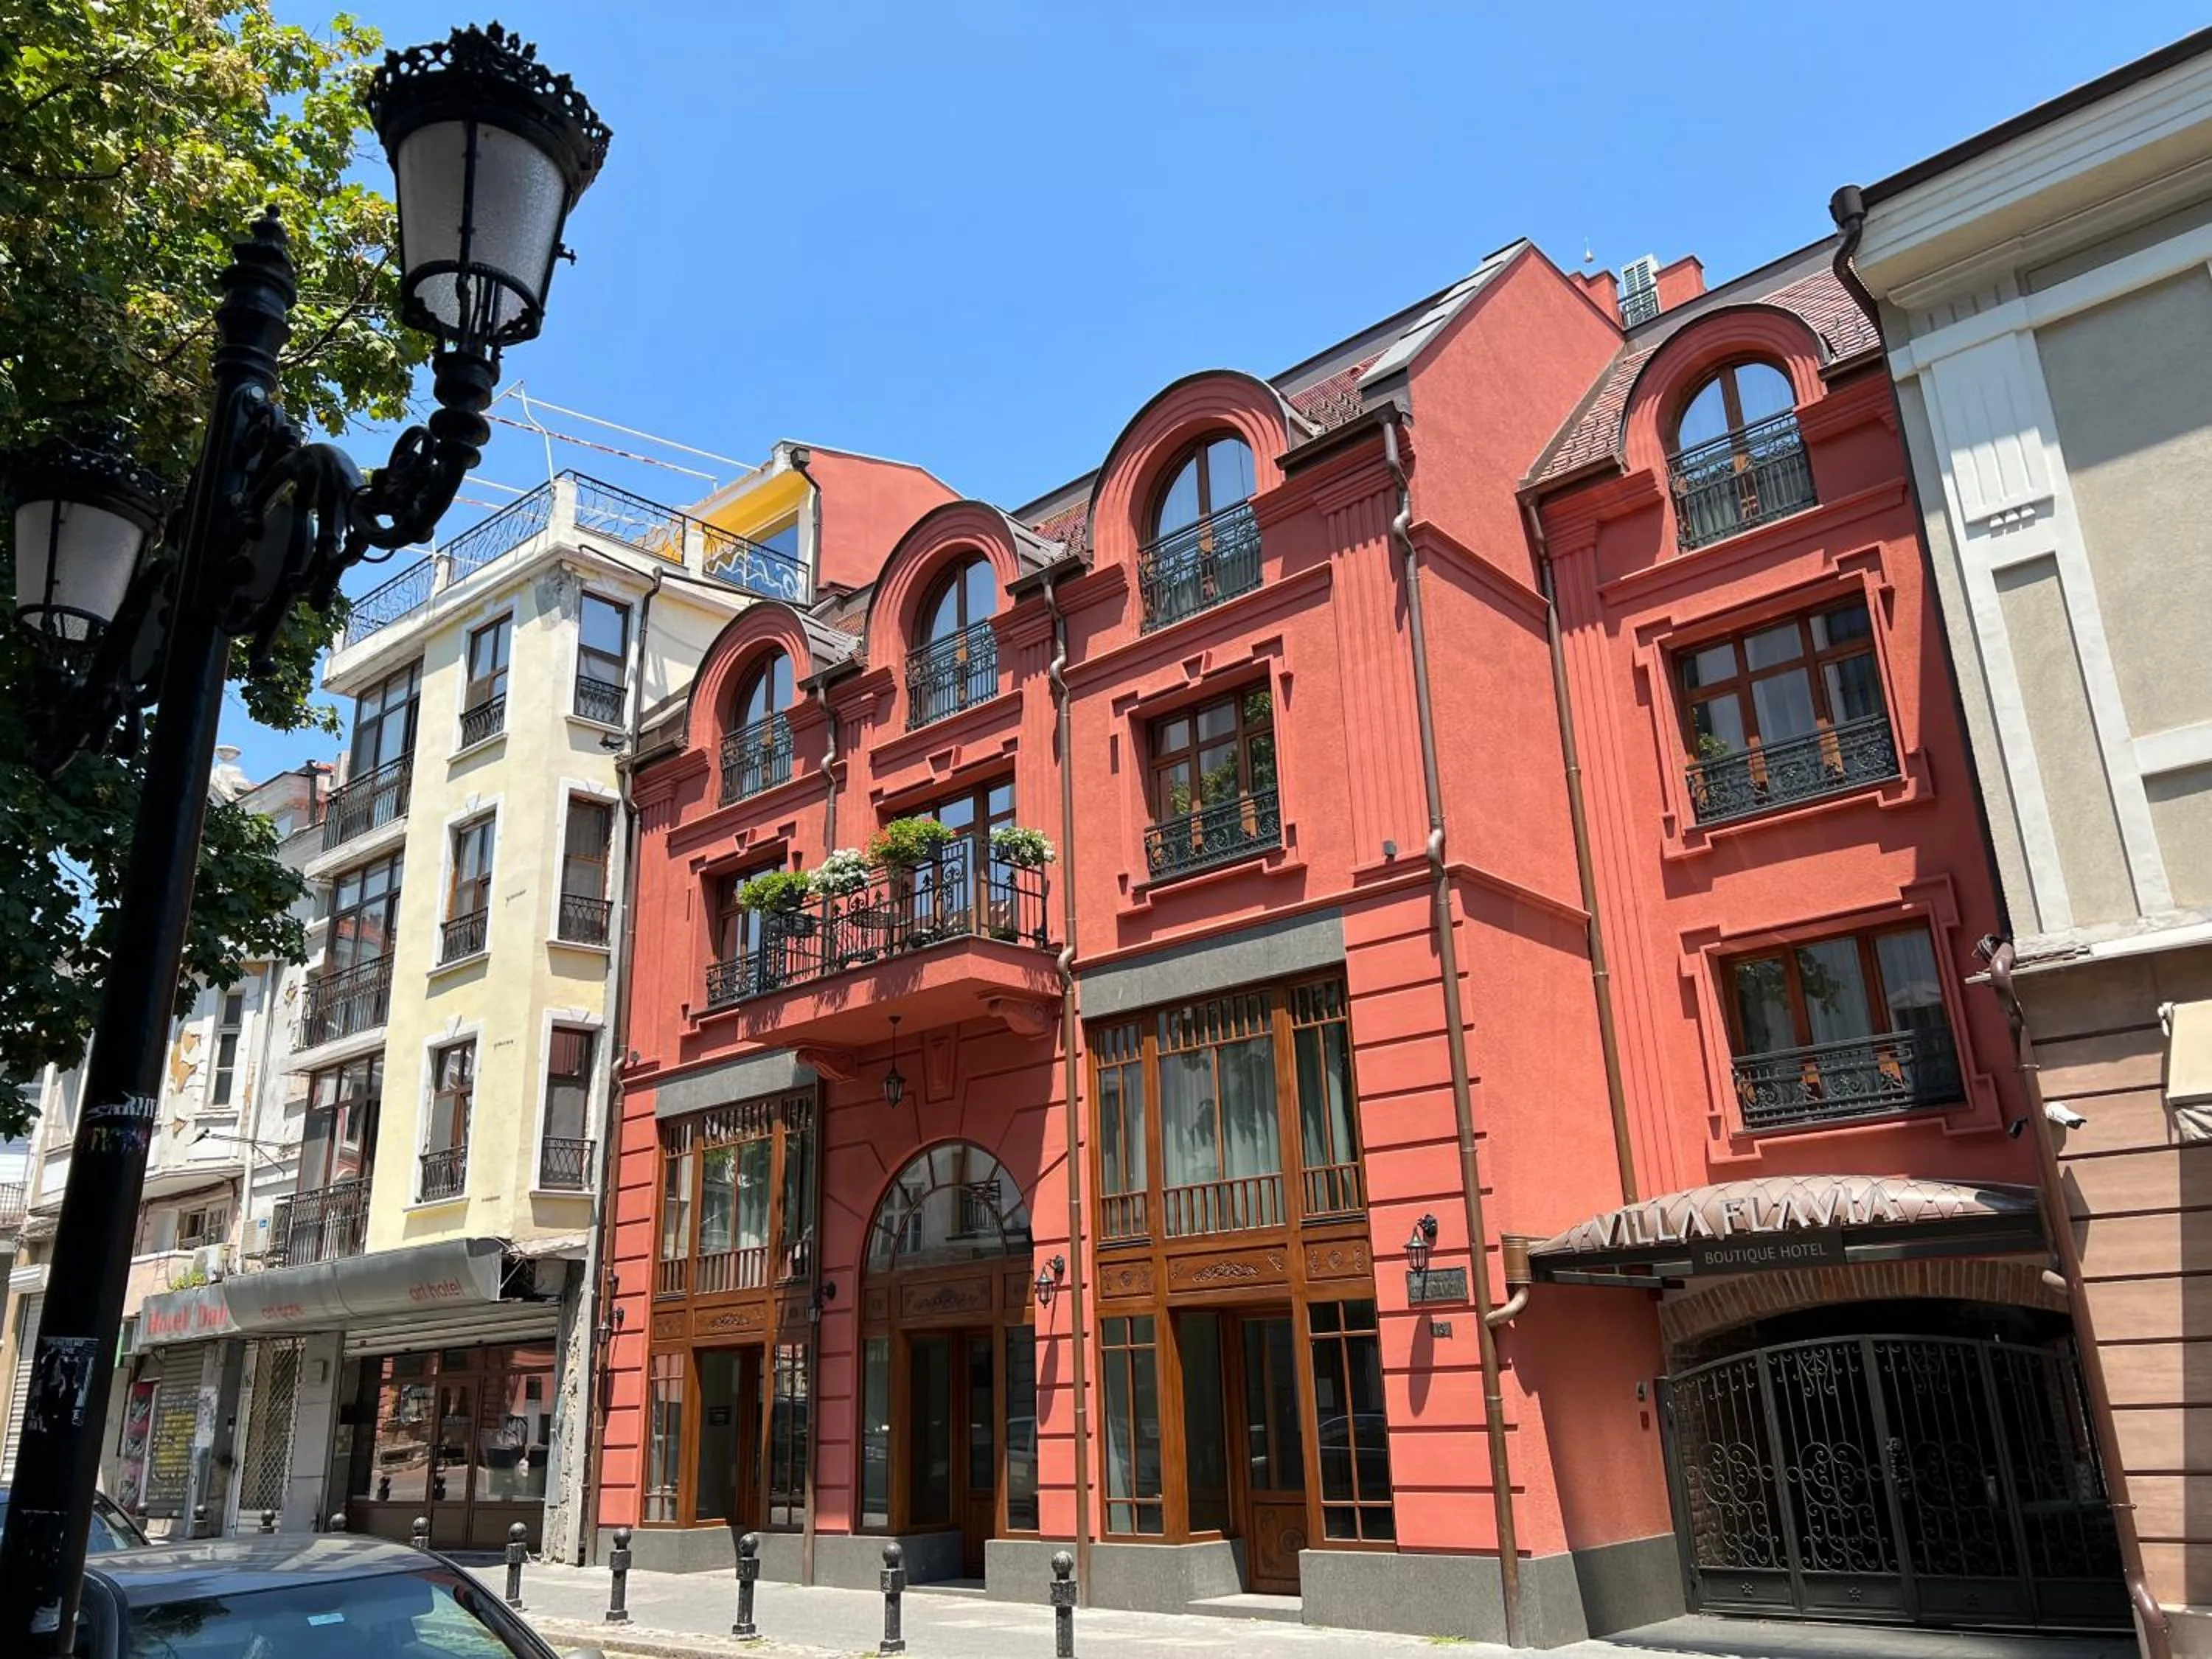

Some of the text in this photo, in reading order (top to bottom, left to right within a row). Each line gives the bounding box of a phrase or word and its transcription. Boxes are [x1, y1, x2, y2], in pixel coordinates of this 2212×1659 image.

[1593, 1184, 1899, 1248] VILLA FLAVIA
[1705, 1243, 1828, 1265] BOUTIQUE HOTEL
[427, 1276, 466, 1298] hotel
